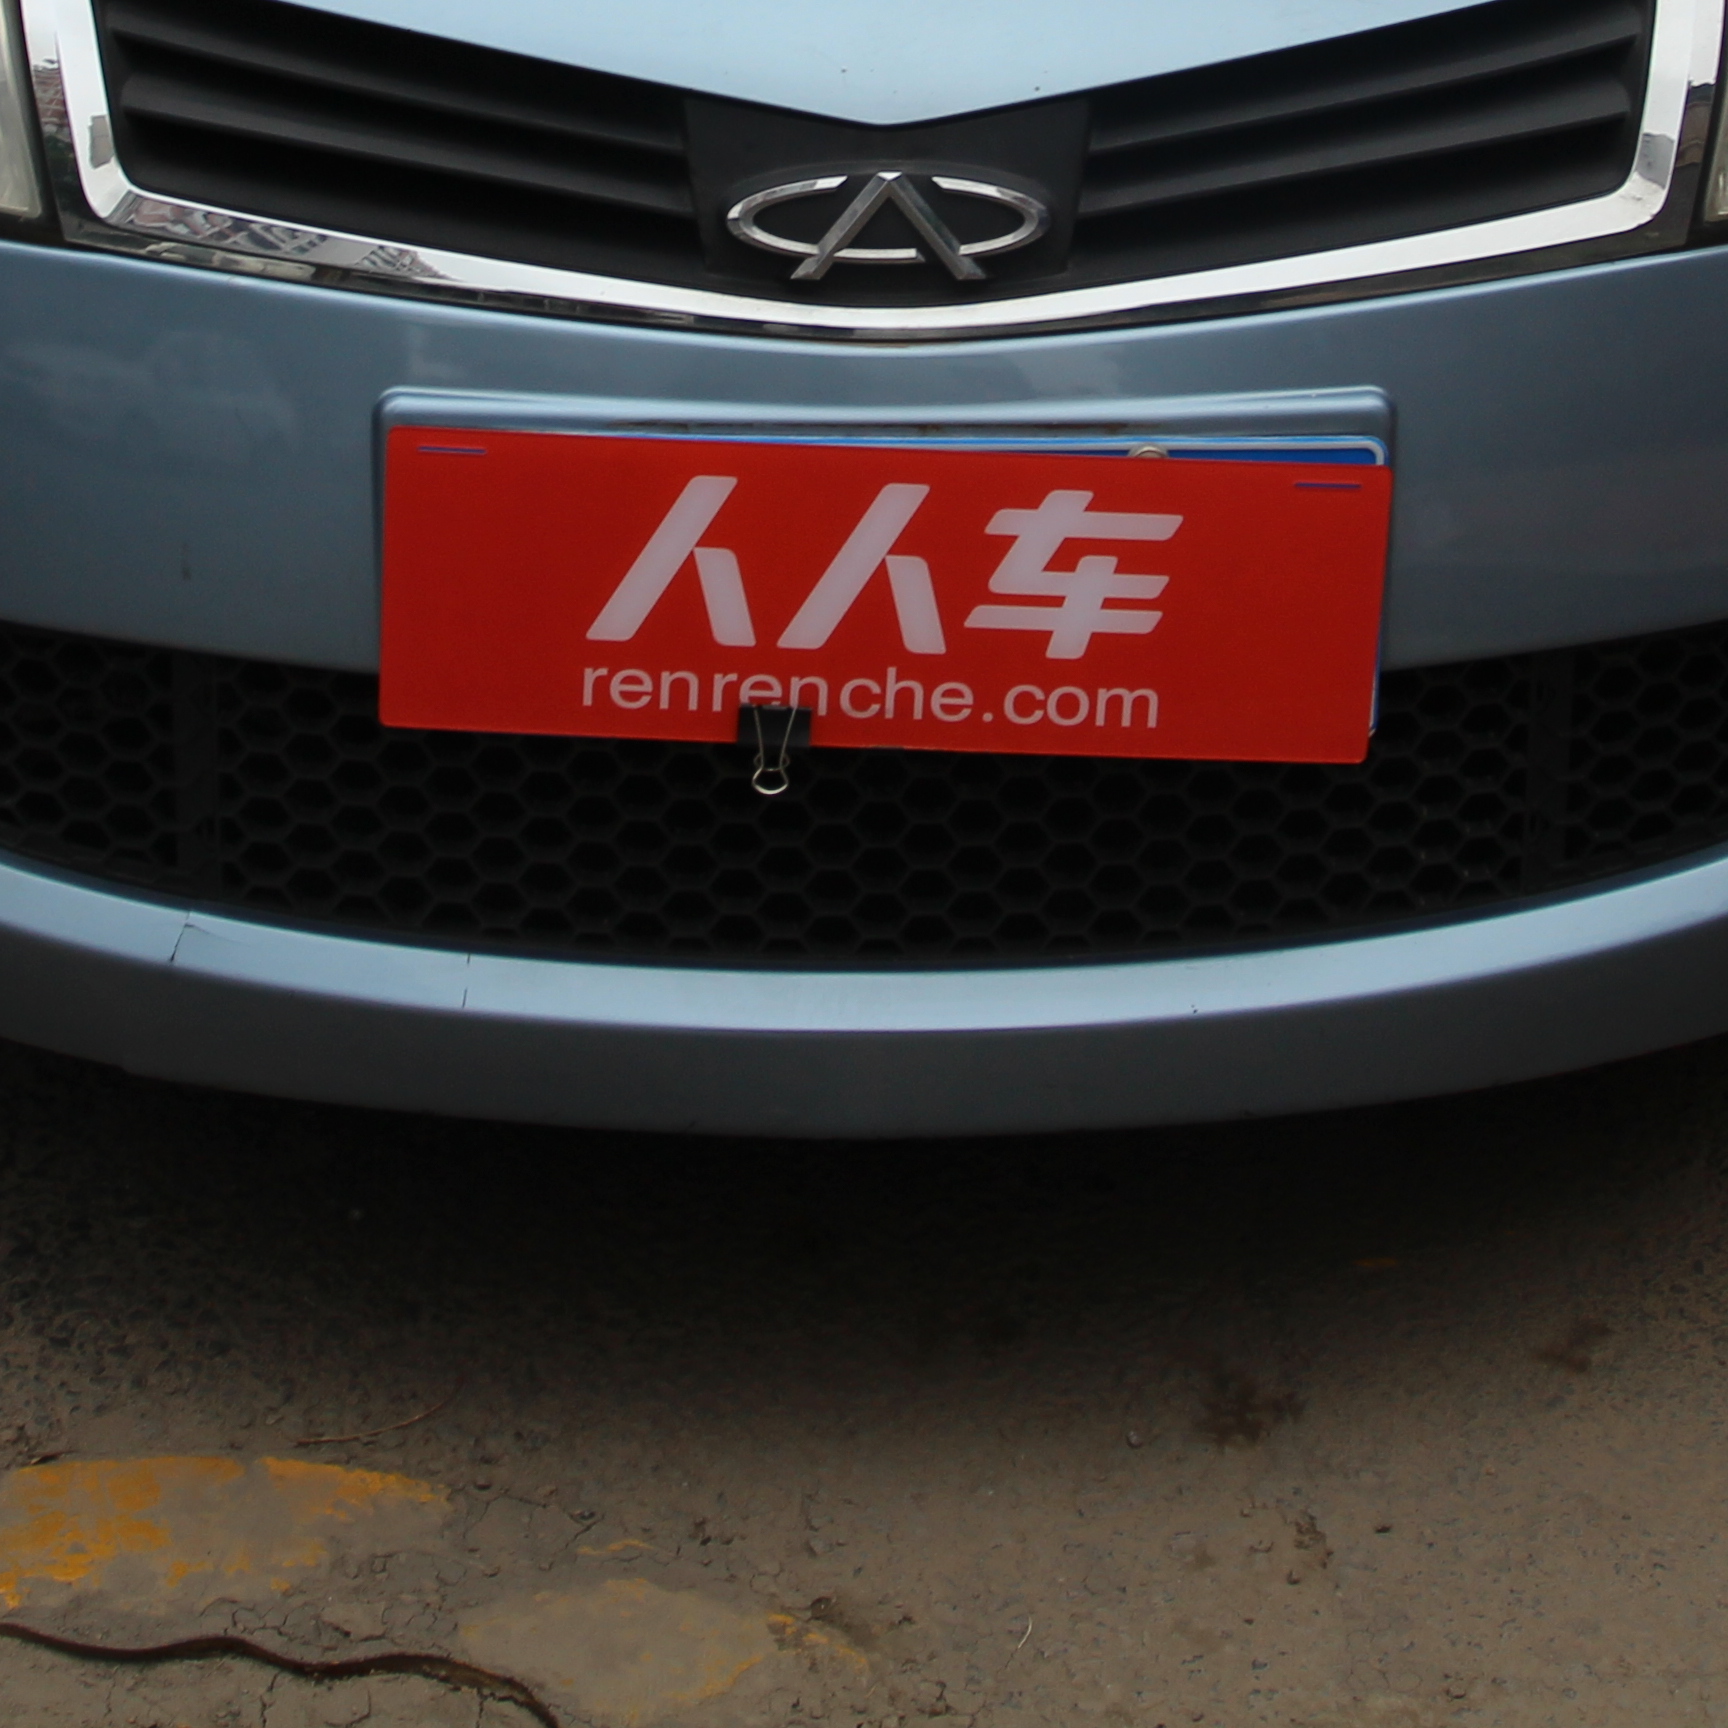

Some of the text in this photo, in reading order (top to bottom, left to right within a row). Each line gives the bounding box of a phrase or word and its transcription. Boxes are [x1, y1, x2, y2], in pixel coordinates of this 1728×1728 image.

[585, 475, 1184, 659] 人人车
[582, 666, 1159, 729] renrenche.com
